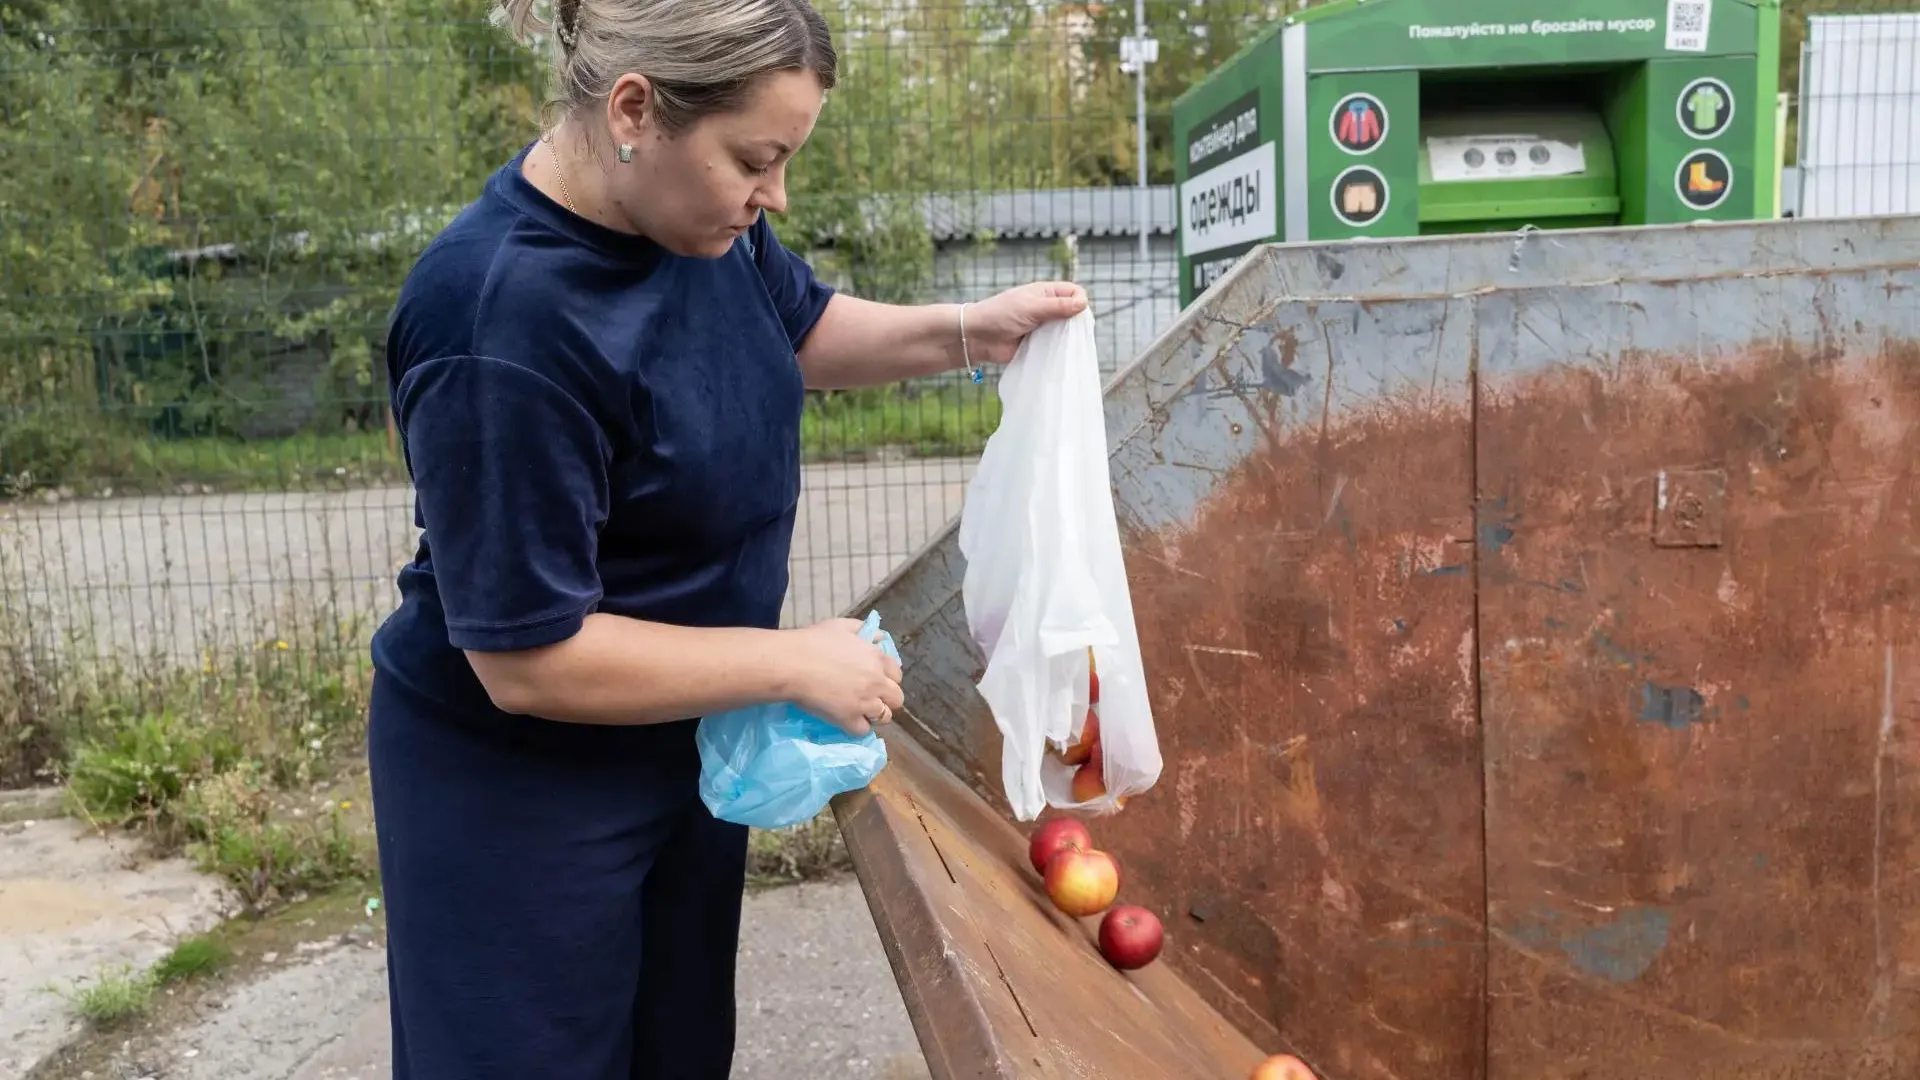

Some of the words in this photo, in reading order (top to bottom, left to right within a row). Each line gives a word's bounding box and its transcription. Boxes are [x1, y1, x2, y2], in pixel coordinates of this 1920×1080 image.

[1408, 22, 1505, 39] Пожалуйста
[1508, 23, 1529, 35] не
[1531, 18, 1605, 37] бросайте
[1607, 18, 1656, 33] мусор
[1236, 107, 1257, 145] для
[1190, 169, 1260, 236] одежды
